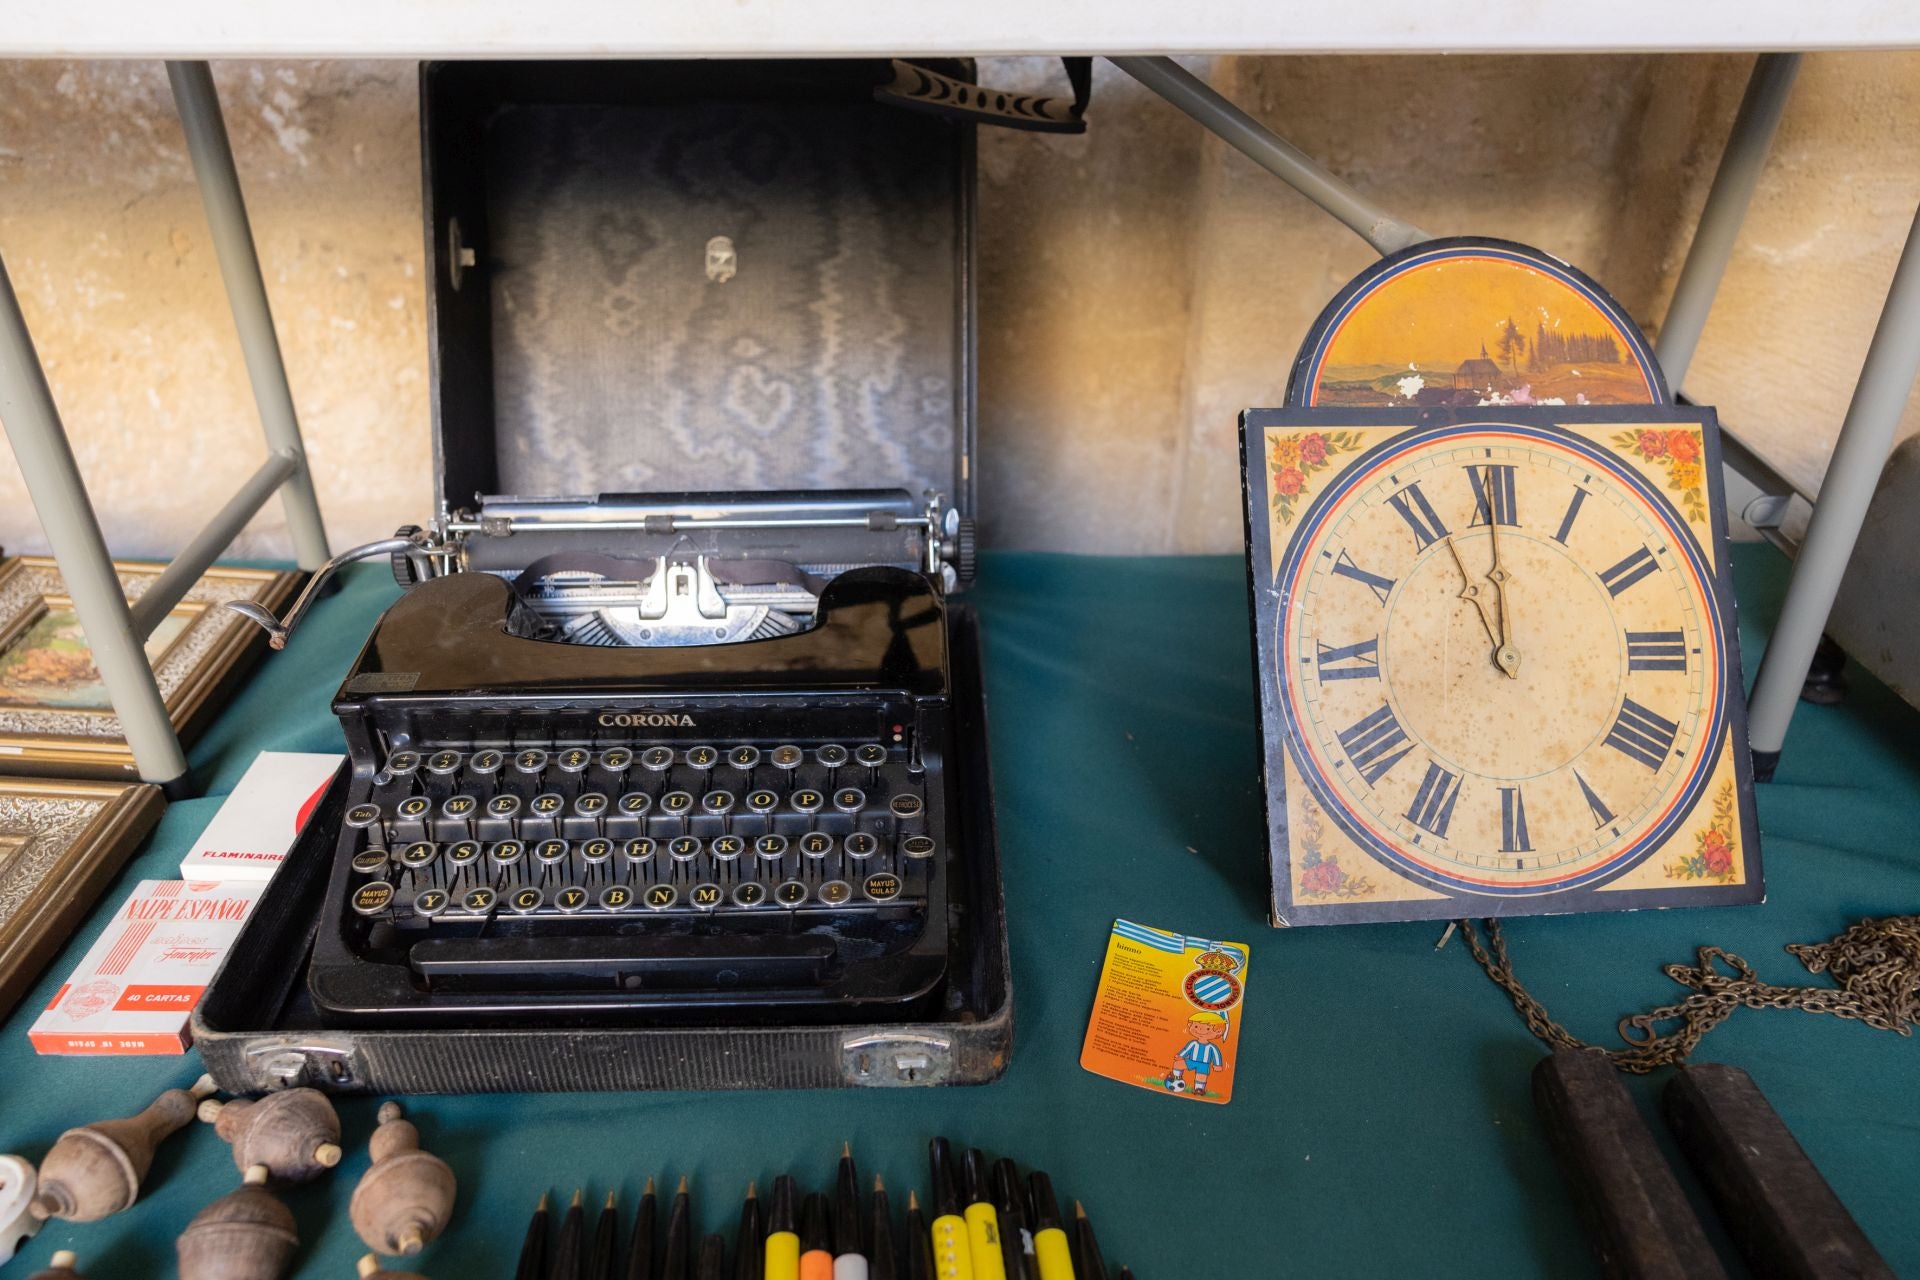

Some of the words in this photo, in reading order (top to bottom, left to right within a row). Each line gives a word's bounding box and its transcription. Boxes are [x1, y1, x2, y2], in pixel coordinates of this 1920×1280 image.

[1383, 480, 1452, 554] XI
[1462, 464, 1522, 529] XII
[1550, 484, 1592, 548] I
[1331, 548, 1398, 607] X
[1596, 543, 1662, 599] II
[1317, 634, 1381, 686] IX
[1625, 626, 1687, 676] III
[598, 714, 697, 727] CORONA
[1334, 699, 1418, 789] VIII
[1601, 694, 1680, 775] IIII
[407, 801, 424, 813] Q
[451, 801, 470, 811] W
[498, 800, 512, 811] E
[540, 799, 556, 809] R
[584, 798, 600, 809] T
[628, 798, 642, 809] Z
[670, 797, 685, 808] U
[714, 795, 722, 807] I
[754, 794, 771, 805] O
[801, 794, 815, 805] P
[1402, 759, 1465, 840] VII
[1496, 784, 1537, 852] VI
[1572, 768, 1617, 831] V
[202, 851, 285, 861] FLAMINAIRE
[411, 846, 426, 857] A
[456, 846, 471, 858] S
[499, 845, 517, 857] D
[545, 844, 561, 856] F
[589, 844, 605, 855] G
[631, 844, 648, 855] H
[679, 841, 690, 852] J
[720, 840, 735, 851] K
[766, 840, 779, 850] L
[122, 899, 180, 920] NAIPE
[173, 897, 250, 920] ESPAÑOL
[360, 897, 386, 905] CULAS
[362, 889, 389, 898] MAYUS
[425, 895, 440, 907] Y
[471, 894, 488, 906] X
[518, 893, 535, 906] C
[566, 892, 581, 905] V
[609, 891, 624, 904] B
[653, 890, 671, 903] N
[697, 889, 716, 902] M
[870, 880, 895, 888] MAYUS
[870, 887, 895, 895] CULAS
[127, 994, 140, 1002] 40
[145, 994, 191, 1002] CARTAS
